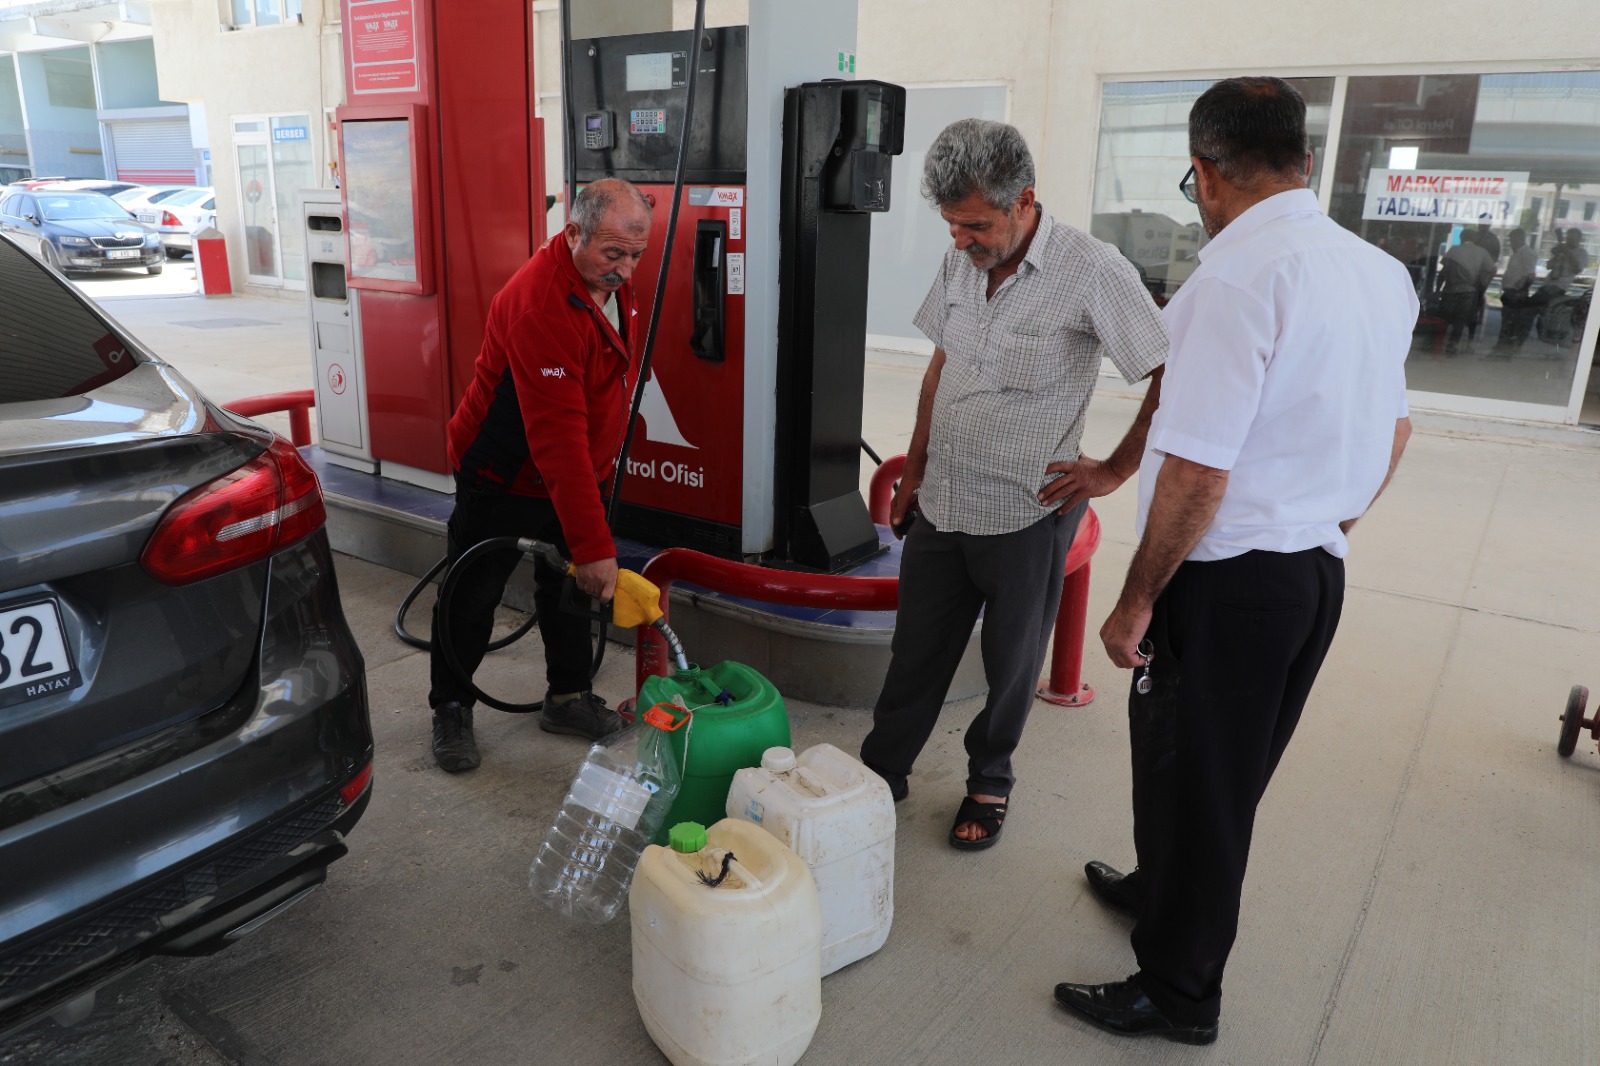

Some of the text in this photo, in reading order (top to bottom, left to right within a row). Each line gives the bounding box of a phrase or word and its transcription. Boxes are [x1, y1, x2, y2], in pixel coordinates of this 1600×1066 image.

[275, 128, 305, 139] BERBER
[612, 456, 704, 488] trol Ofisi
[0, 615, 53, 684] 2
[26, 676, 71, 697] HATAY
